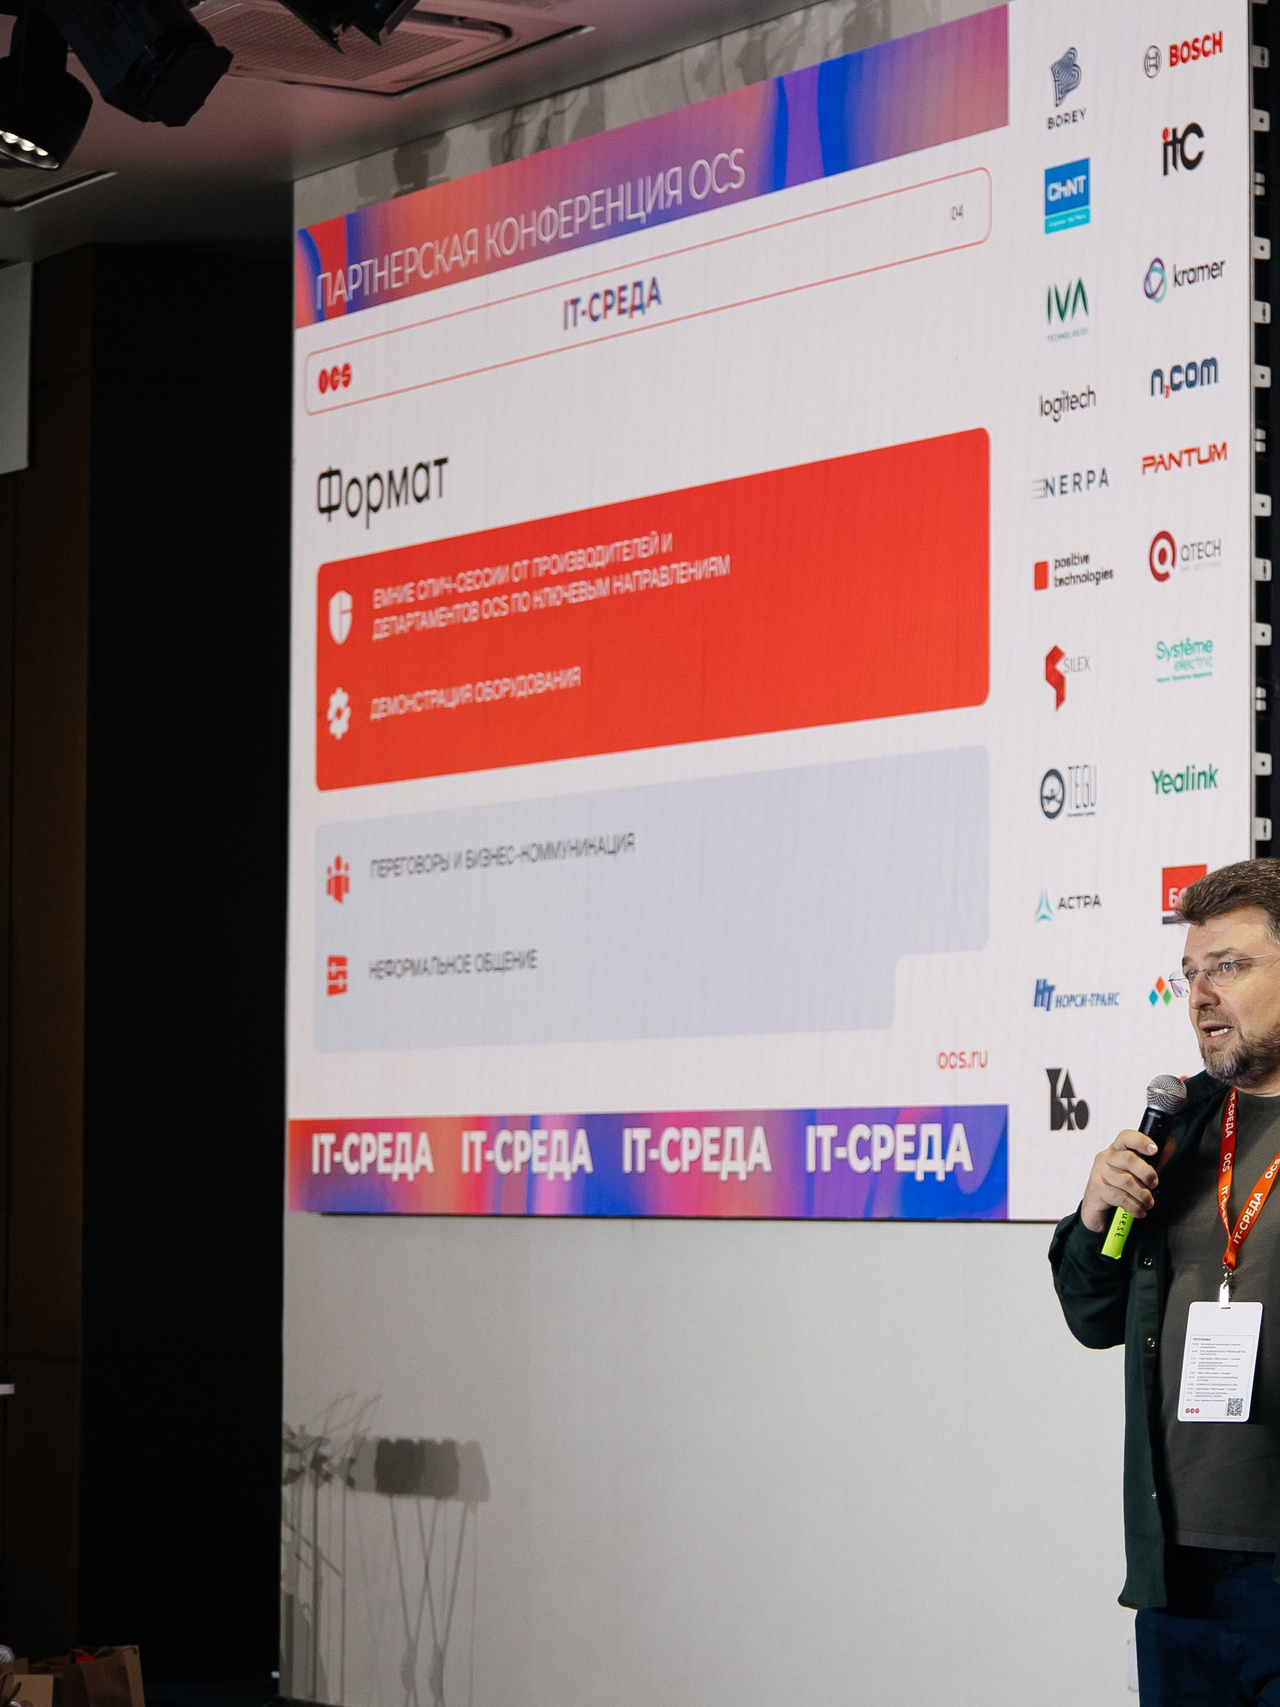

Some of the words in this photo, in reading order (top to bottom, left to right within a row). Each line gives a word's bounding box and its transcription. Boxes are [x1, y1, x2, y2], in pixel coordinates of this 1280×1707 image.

[1168, 30, 1223, 67] BOSCH
[1047, 108, 1087, 130] BOREY
[316, 234, 479, 311] ПАРТНЕРСКАЯ
[486, 166, 682, 260] КОНФЕРЕНЦИЯ
[688, 147, 747, 200] OCS
[1173, 259, 1226, 288] kramer
[563, 276, 662, 331] IT-СРЕДА
[1047, 277, 1089, 326] IVA
[1039, 384, 1097, 423] logitech
[1141, 441, 1228, 476] PANTUM
[317, 456, 449, 529] Формат
[1043, 468, 1110, 498] NERPA
[510, 559, 530, 583] ОТ
[531, 530, 660, 578] ПРОИЗВОДИТЕЛЕЙ
[661, 532, 673, 555] И
[1054, 552, 1090, 570] positive
[1180, 538, 1222, 562] QTECH
[1054, 567, 1114, 588] technologies
[372, 600, 480, 642] ДЕПАРТАМЕНТОВ
[510, 590, 532, 614] ПО
[532, 575, 610, 610] КЛЮЧЕВЫМ
[611, 553, 731, 596] НАПРАВЛЕНИЯМ
[1062, 655, 1092, 674] SILEX
[369, 682, 473, 721] ДЕМОНСТРАЦИЯ
[474, 665, 582, 703] ОБОРУДОВАНИЯ
[1067, 764, 1098, 810] TEGU
[1151, 762, 1219, 795] Yealink
[370, 851, 450, 879] ПЕРЕГОВОРЫ
[453, 849, 464, 870] И
[1058, 893, 1102, 911] АСТРА
[368, 952, 472, 980] НЕФОРМАЛЬНОЕ
[474, 948, 539, 974] ОБЩЕНИЕ
[937, 1050, 989, 1070] ocs.ru
[312, 1131, 434, 1183] IT-СРЕДА
[460, 1128, 594, 1183] IT-СРЕДА
[622, 1125, 773, 1183] IT-СРЕДА
[805, 1122, 974, 1183] IT-СРЕДА
[1222, 1152, 1232, 1173] OCS
[1233, 1192, 1264, 1245] IT-СРЕДА
